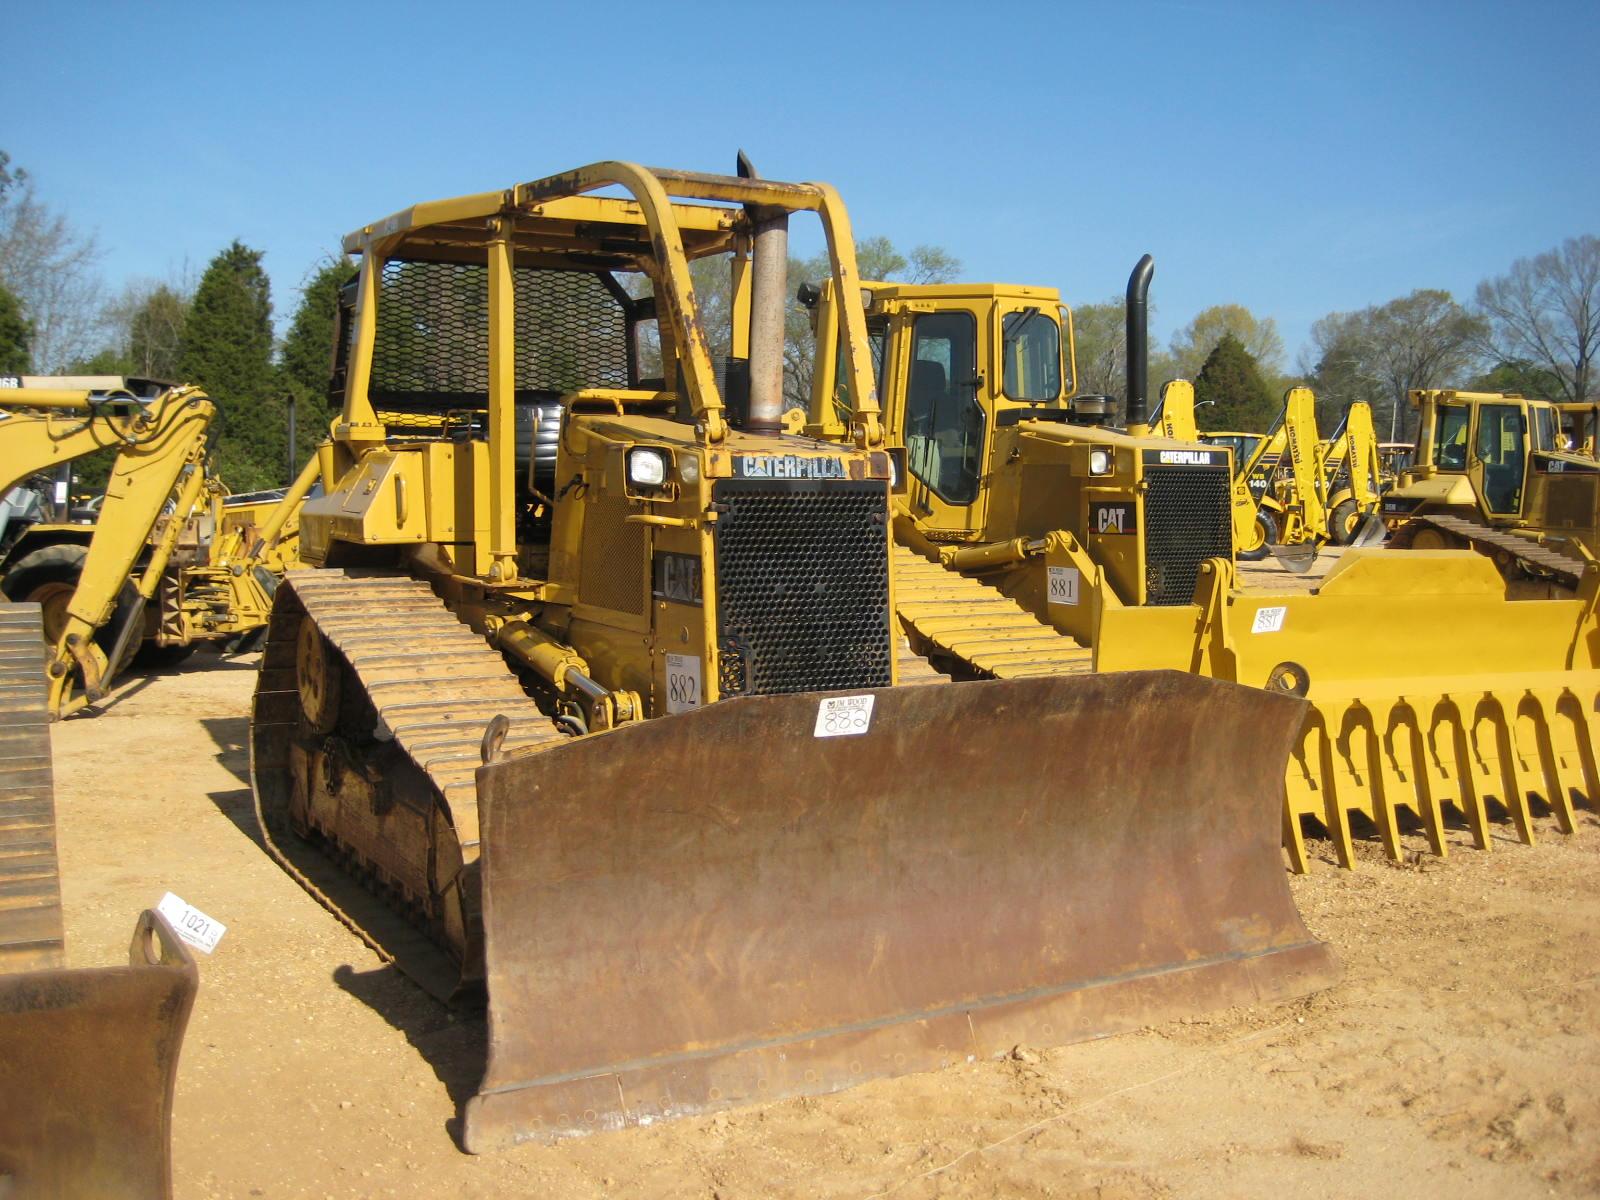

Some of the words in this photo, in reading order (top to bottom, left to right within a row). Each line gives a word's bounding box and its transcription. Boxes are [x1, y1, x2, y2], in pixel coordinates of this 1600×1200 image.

[1289, 425, 1301, 464] KOMATSU
[1349, 435, 1358, 468] KOMATSU
[1160, 451, 1210, 465] CATERPILLAR
[1548, 460, 1566, 473] CAT
[1249, 480, 1267, 488] 140
[1097, 508, 1126, 534] CAT
[663, 555, 698, 602] CAT
[1051, 578, 1072, 597] 881
[670, 673, 696, 704] 882
[824, 708, 868, 732] 882
[180, 910, 210, 937] 1021
